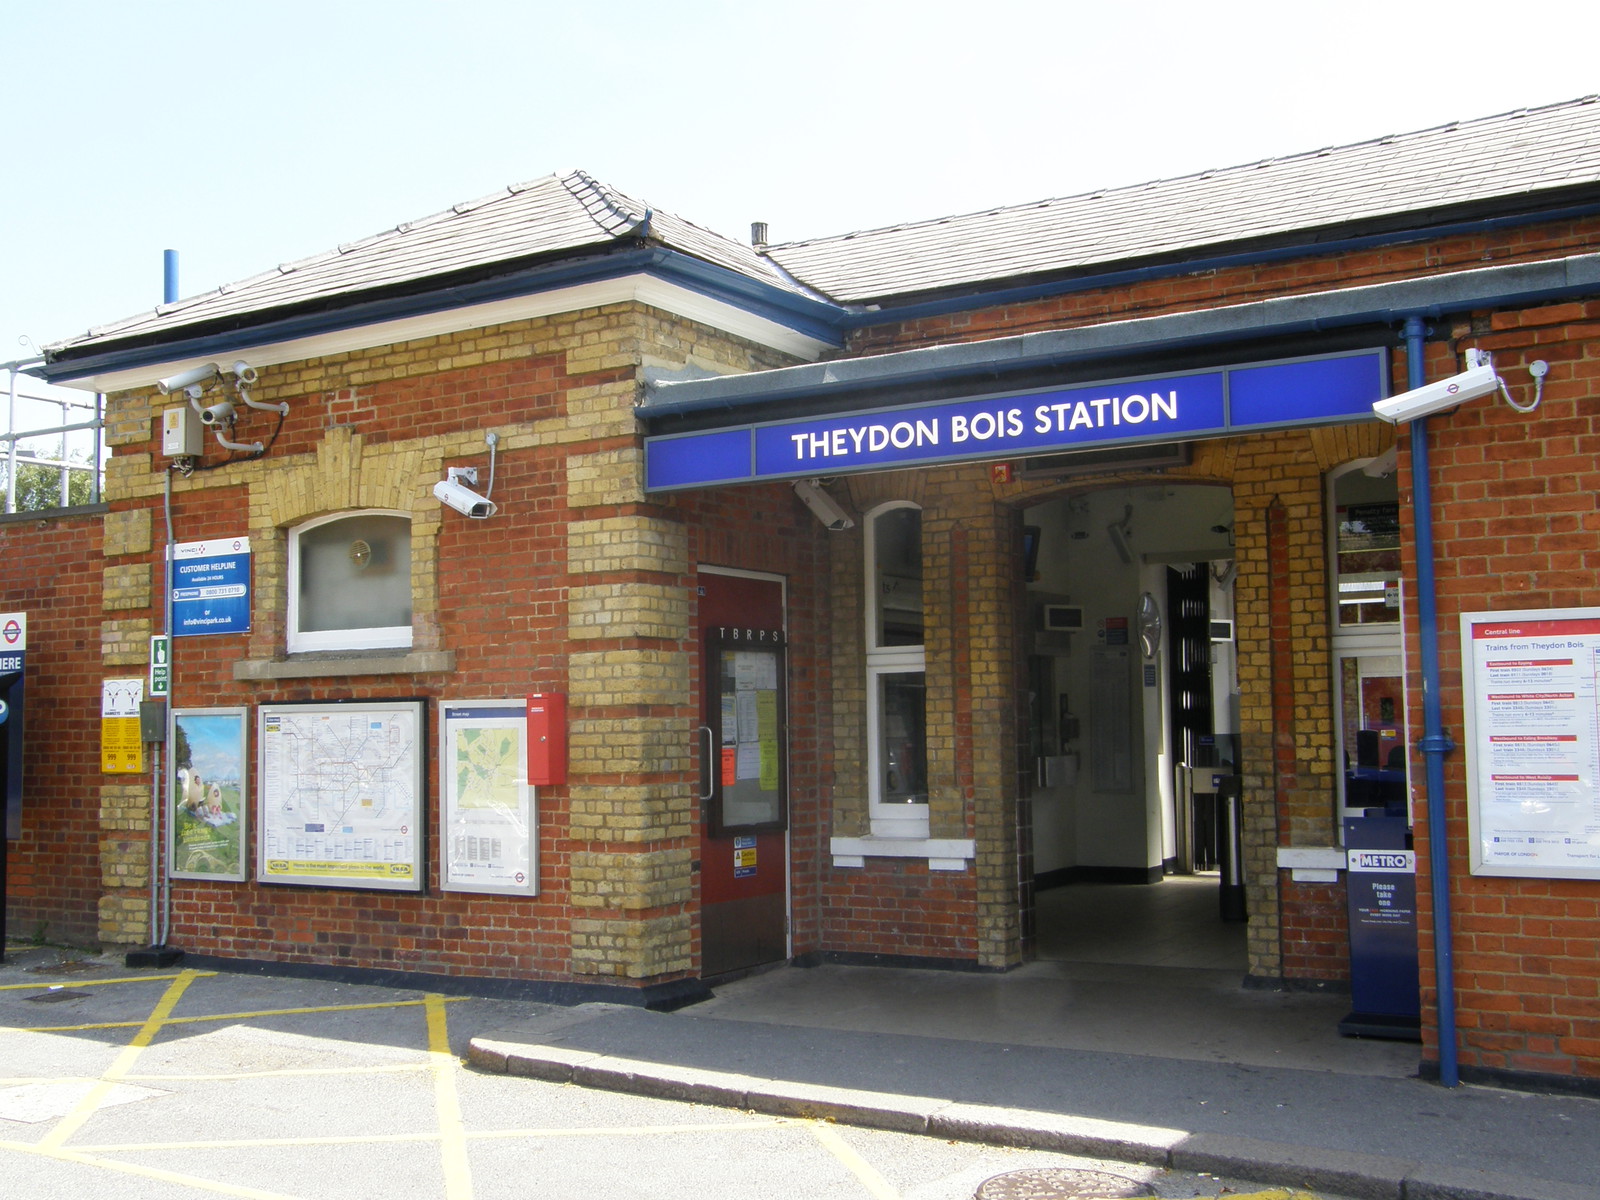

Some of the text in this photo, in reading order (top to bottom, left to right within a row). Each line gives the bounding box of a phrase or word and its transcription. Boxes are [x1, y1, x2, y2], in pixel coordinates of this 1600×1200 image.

[791, 391, 1178, 460] THEYDON BOIS STATION
[180, 562, 236, 573] CUSTOMER HELPLINE
[184, 616, 232, 626] info@vincipark.co.uk
[1532, 642, 1565, 650] Theydon
[0, 657, 21, 670] ERE
[1361, 855, 1405, 867] METRO
